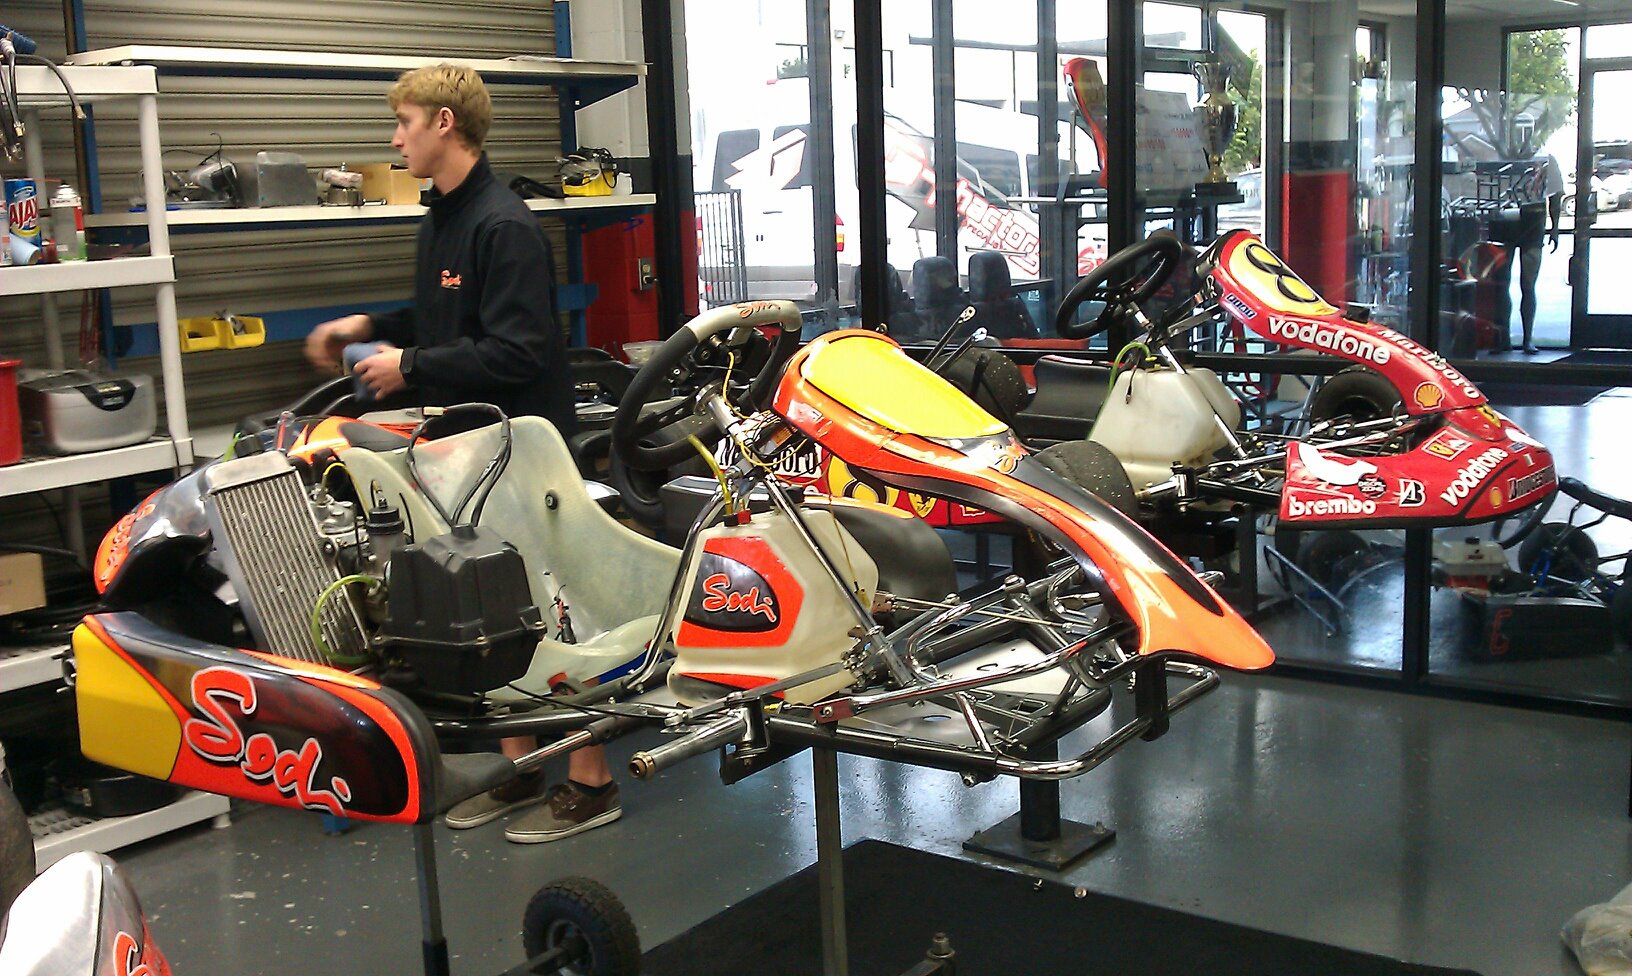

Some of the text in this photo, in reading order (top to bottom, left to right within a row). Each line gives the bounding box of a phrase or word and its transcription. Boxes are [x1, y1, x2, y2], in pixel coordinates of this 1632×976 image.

[1244, 242, 1321, 303] 8
[1268, 316, 1391, 364] vodafone
[1379, 327, 1489, 399] Marlboro
[1288, 495, 1377, 517] brembo
[1440, 447, 1508, 506] vodafone
[702, 573, 777, 622] Sodi
[184, 665, 352, 817] Sodi
